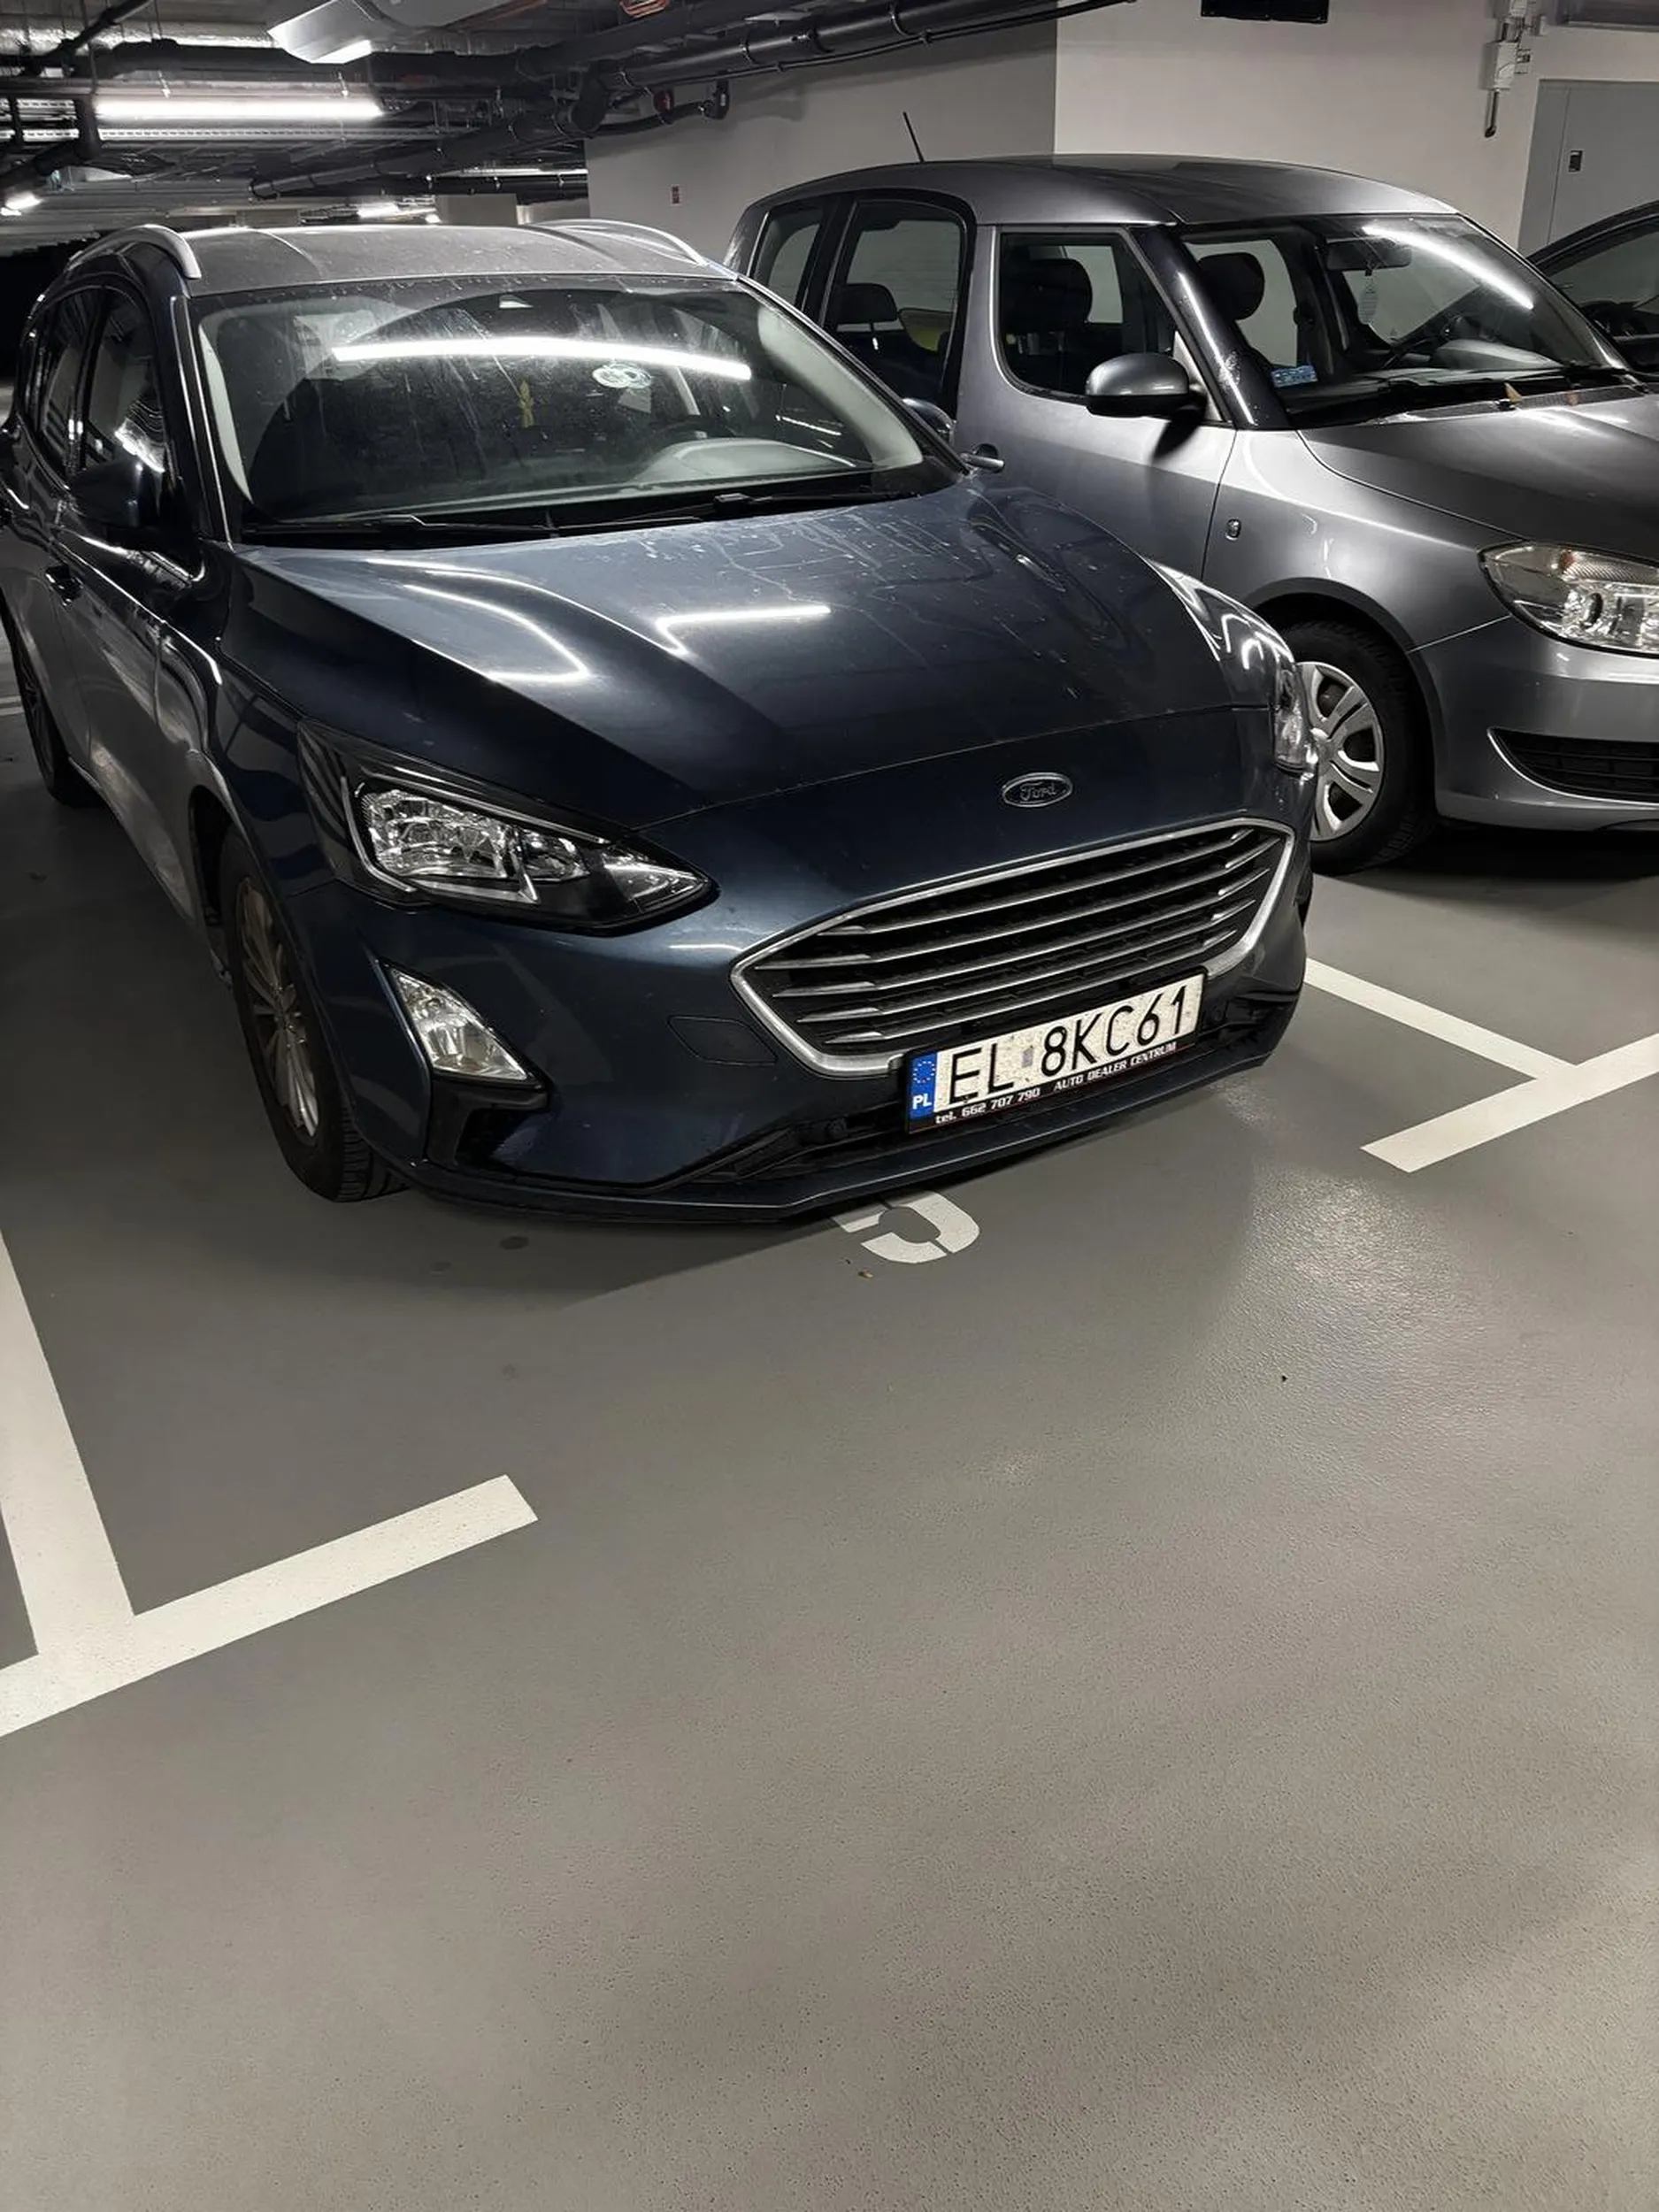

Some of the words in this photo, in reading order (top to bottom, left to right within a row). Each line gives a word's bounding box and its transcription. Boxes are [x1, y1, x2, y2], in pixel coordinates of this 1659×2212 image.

[935, 1110, 957, 1125] tel.
[961, 1102, 986, 1118] 662
[990, 1095, 1013, 1110] 707
[1018, 1087, 1041, 1102] 790
[1053, 1073, 1084, 1092] AUTO
[1087, 1060, 1128, 1081] DEALER
[1130, 1041, 1178, 1067] CENTRUM
[949, 1043, 1015, 1105] EL
[1040, 985, 1187, 1078] 8KC61
[912, 1094, 933, 1110] PL
